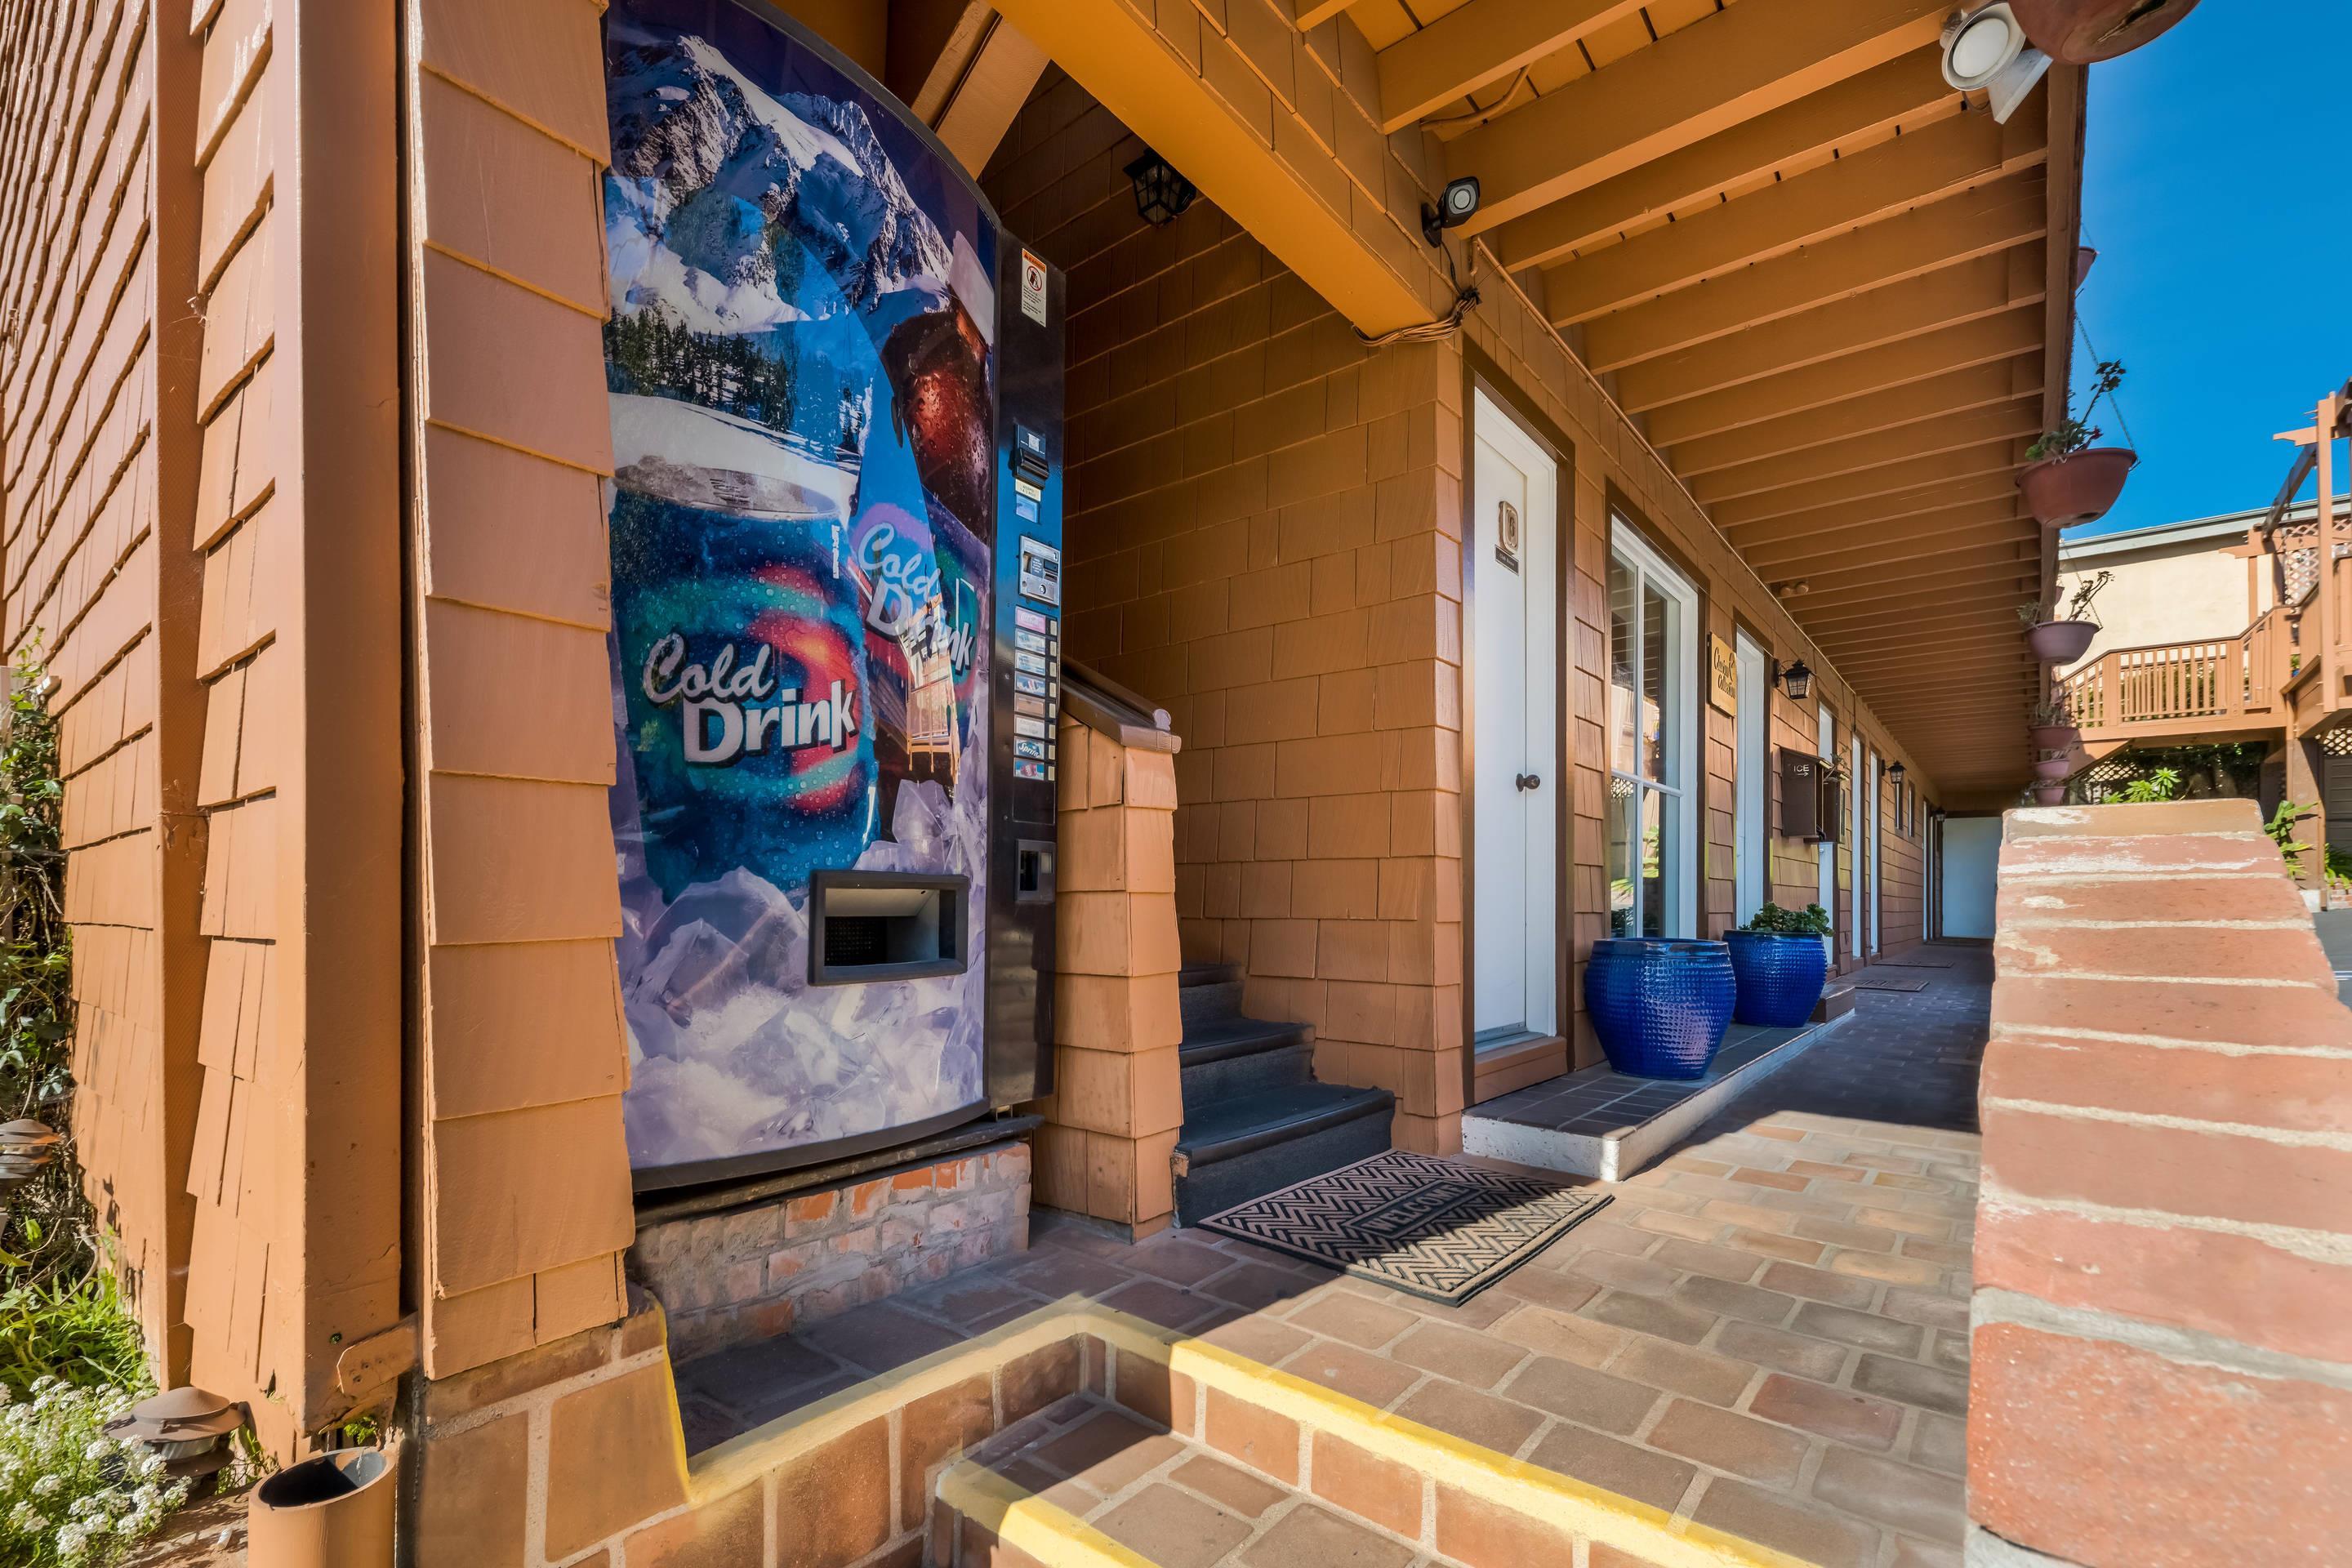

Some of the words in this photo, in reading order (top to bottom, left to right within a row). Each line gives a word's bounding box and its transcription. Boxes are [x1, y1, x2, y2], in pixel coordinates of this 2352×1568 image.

[858, 523, 942, 602] Cold
[643, 632, 774, 703] Cold
[683, 679, 857, 763] Drink
[1018, 742, 1040, 758] Sprite
[1793, 764, 1810, 772] ICE
[1361, 1184, 1470, 1232] WELCOME
